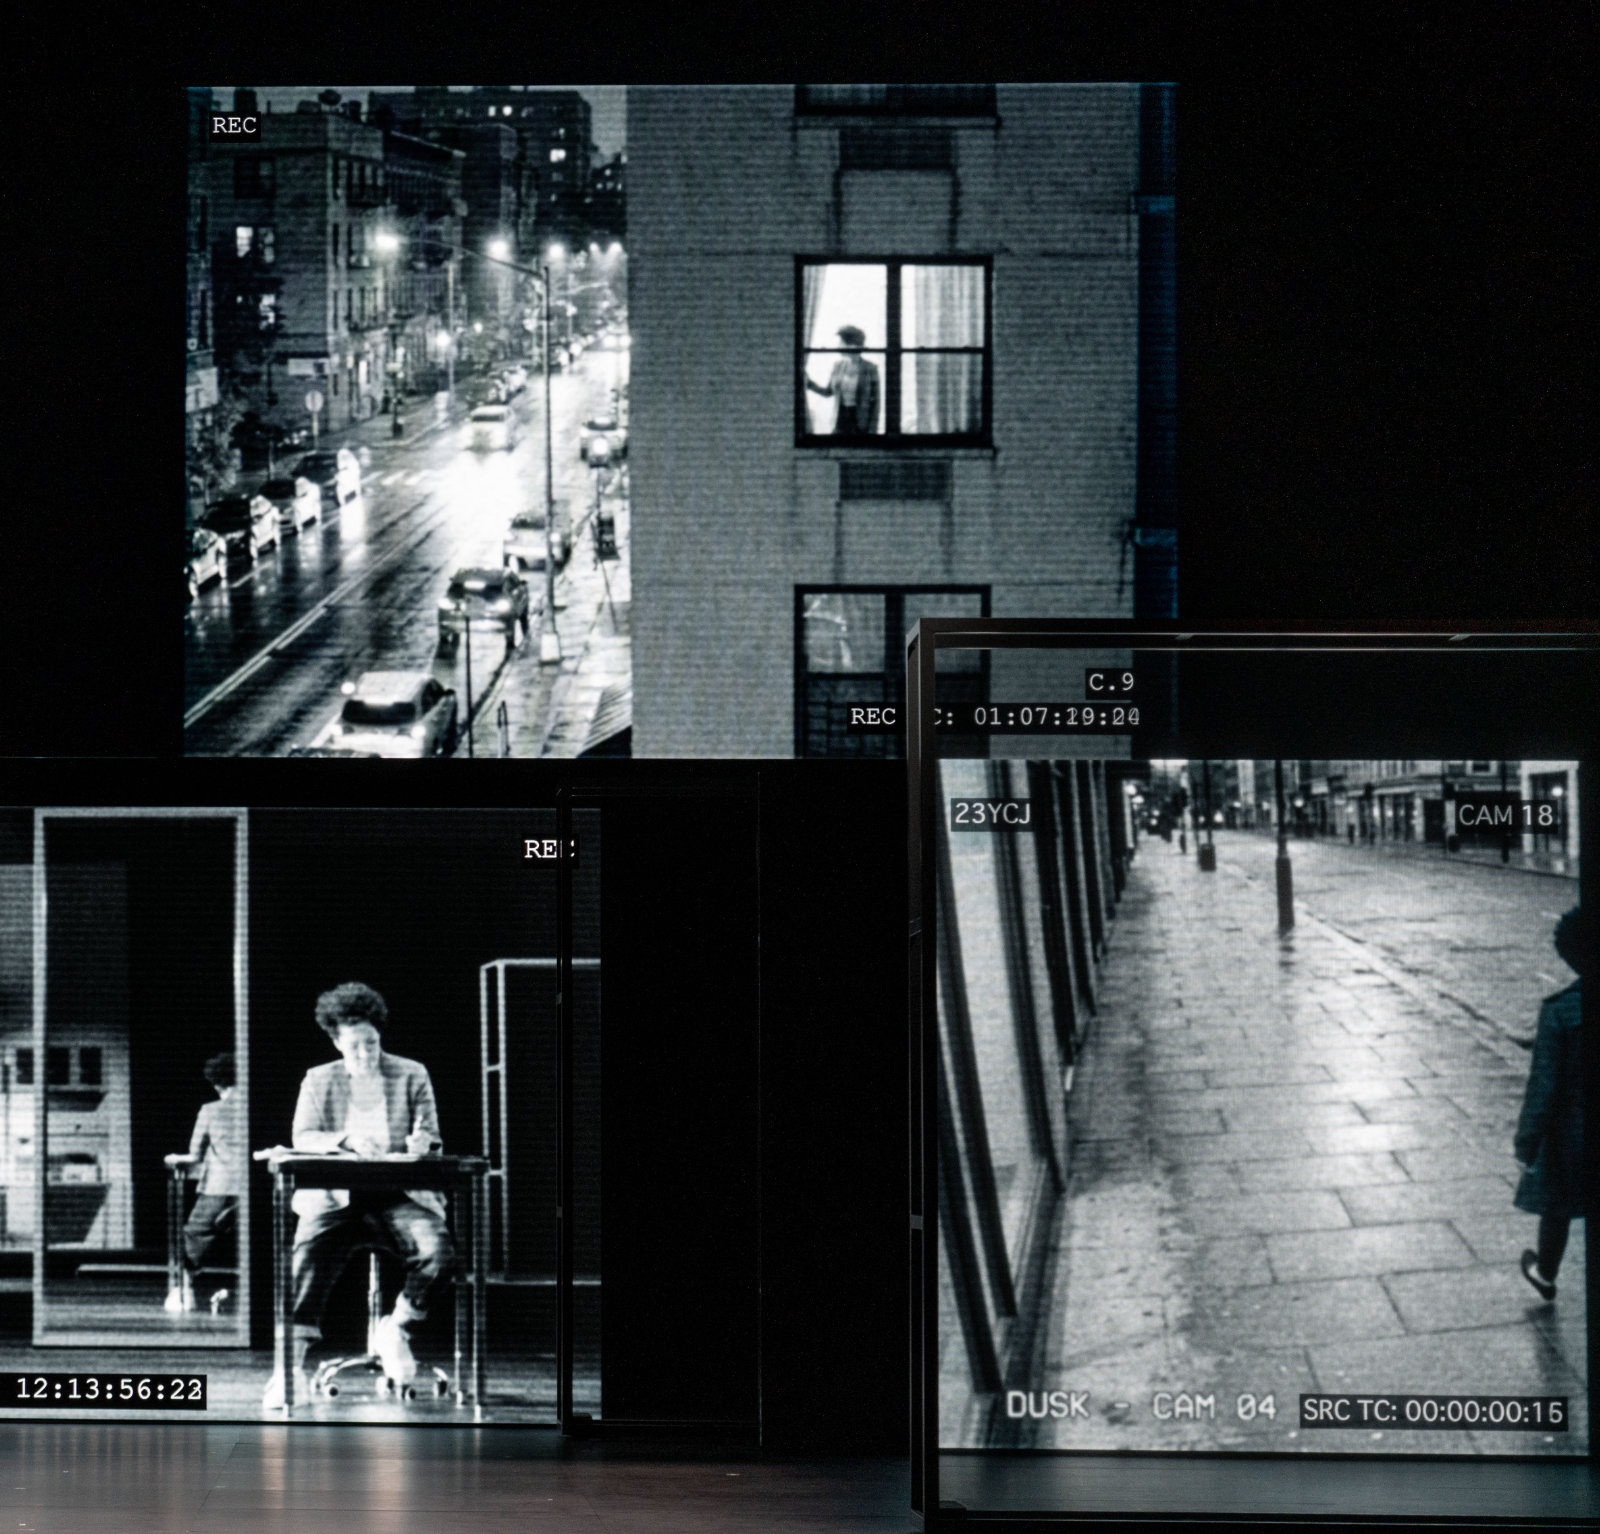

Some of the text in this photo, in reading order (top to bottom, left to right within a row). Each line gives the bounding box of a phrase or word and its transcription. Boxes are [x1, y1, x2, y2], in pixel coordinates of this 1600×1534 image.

[212, 116, 258, 134] REC
[1089, 672, 1134, 691] C.9
[851, 707, 897, 725] REC
[954, 802, 1031, 825] 23YCJ
[1458, 804, 1553, 826] CAM 18
[524, 839, 575, 859] RE
[1006, 1390, 1089, 1418] DUSK
[1152, 1392, 1215, 1420] CAM
[1237, 1393, 1276, 1420] 04
[1303, 1399, 1351, 1421] SRC
[1357, 1399, 1398, 1422] TC:
